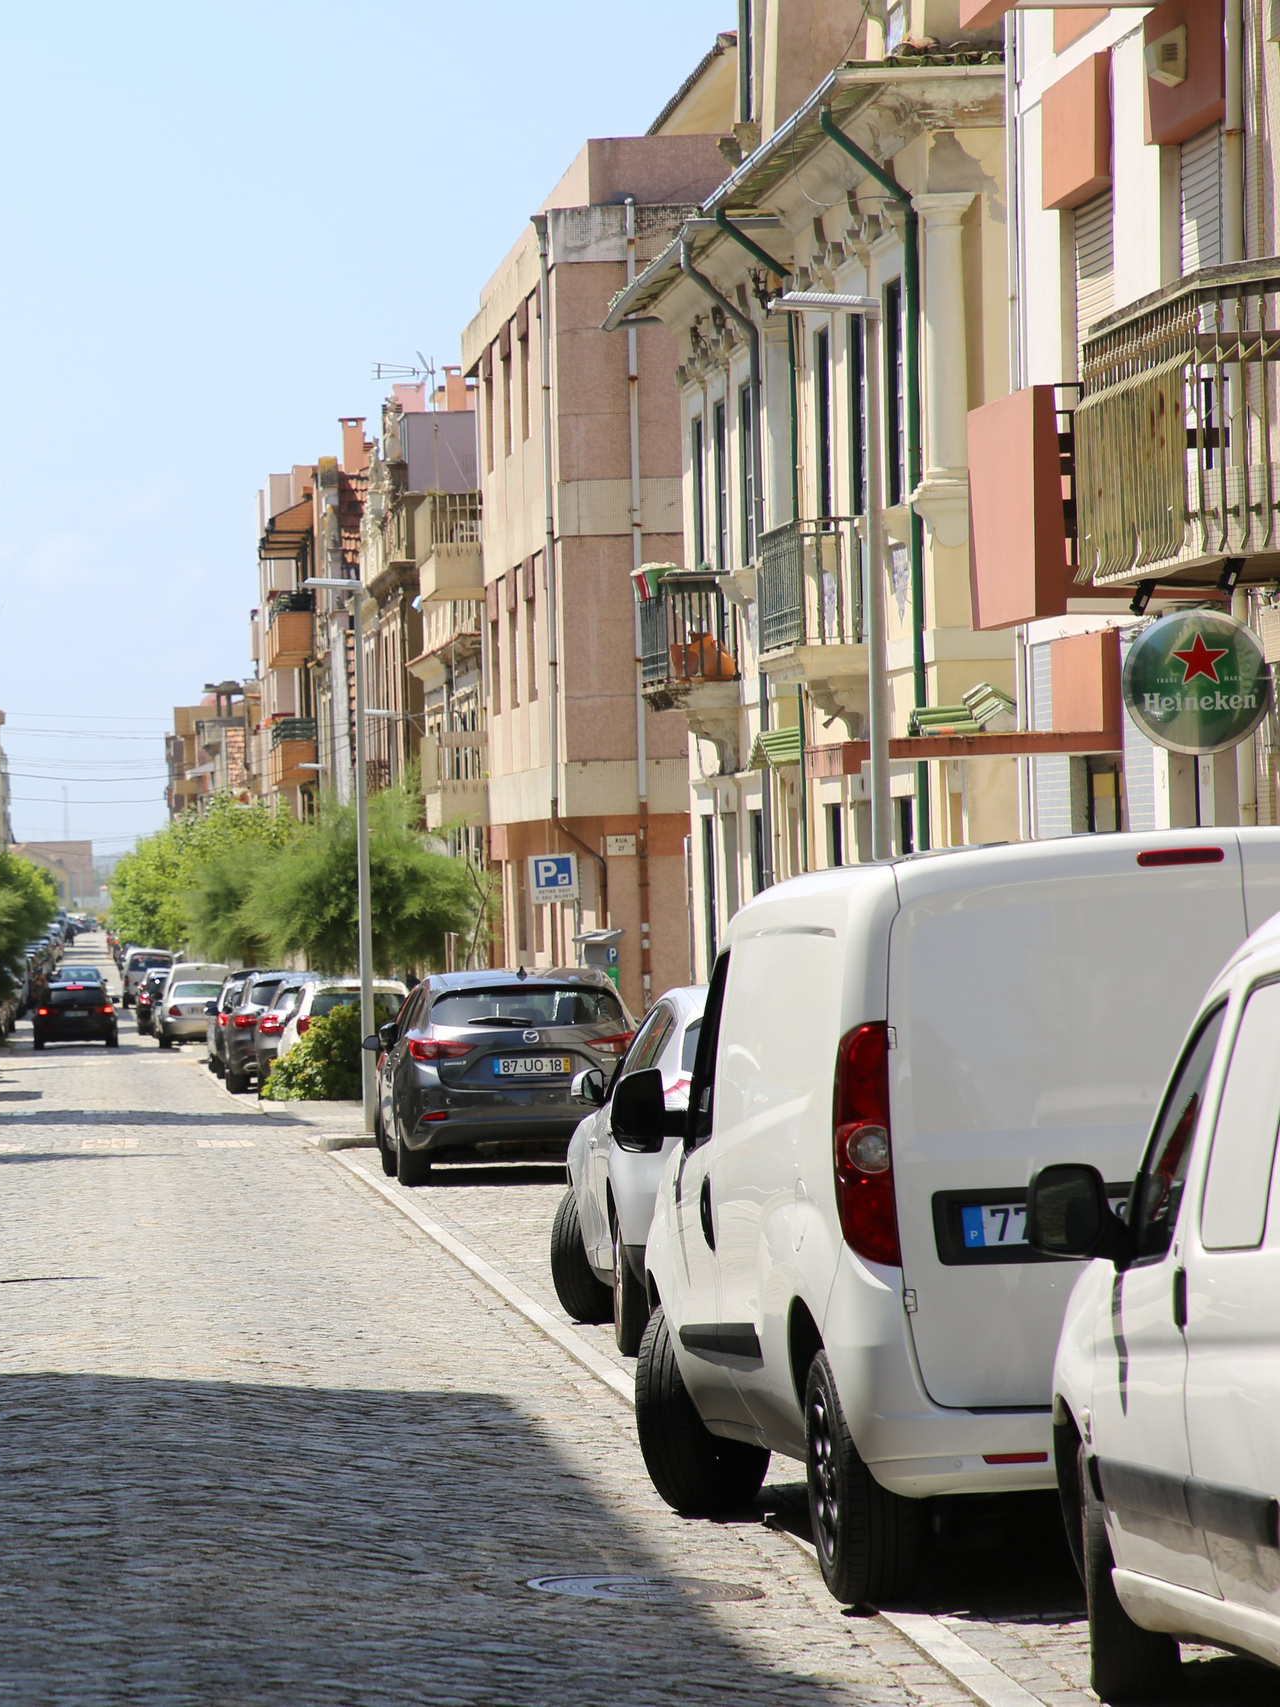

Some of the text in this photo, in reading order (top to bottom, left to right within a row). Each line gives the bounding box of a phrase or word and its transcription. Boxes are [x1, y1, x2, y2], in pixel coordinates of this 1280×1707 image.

[1142, 690, 1258, 712] Heineken
[538, 860, 558, 887] P
[609, 947, 618, 963] P
[970, 1230, 979, 1240] P
